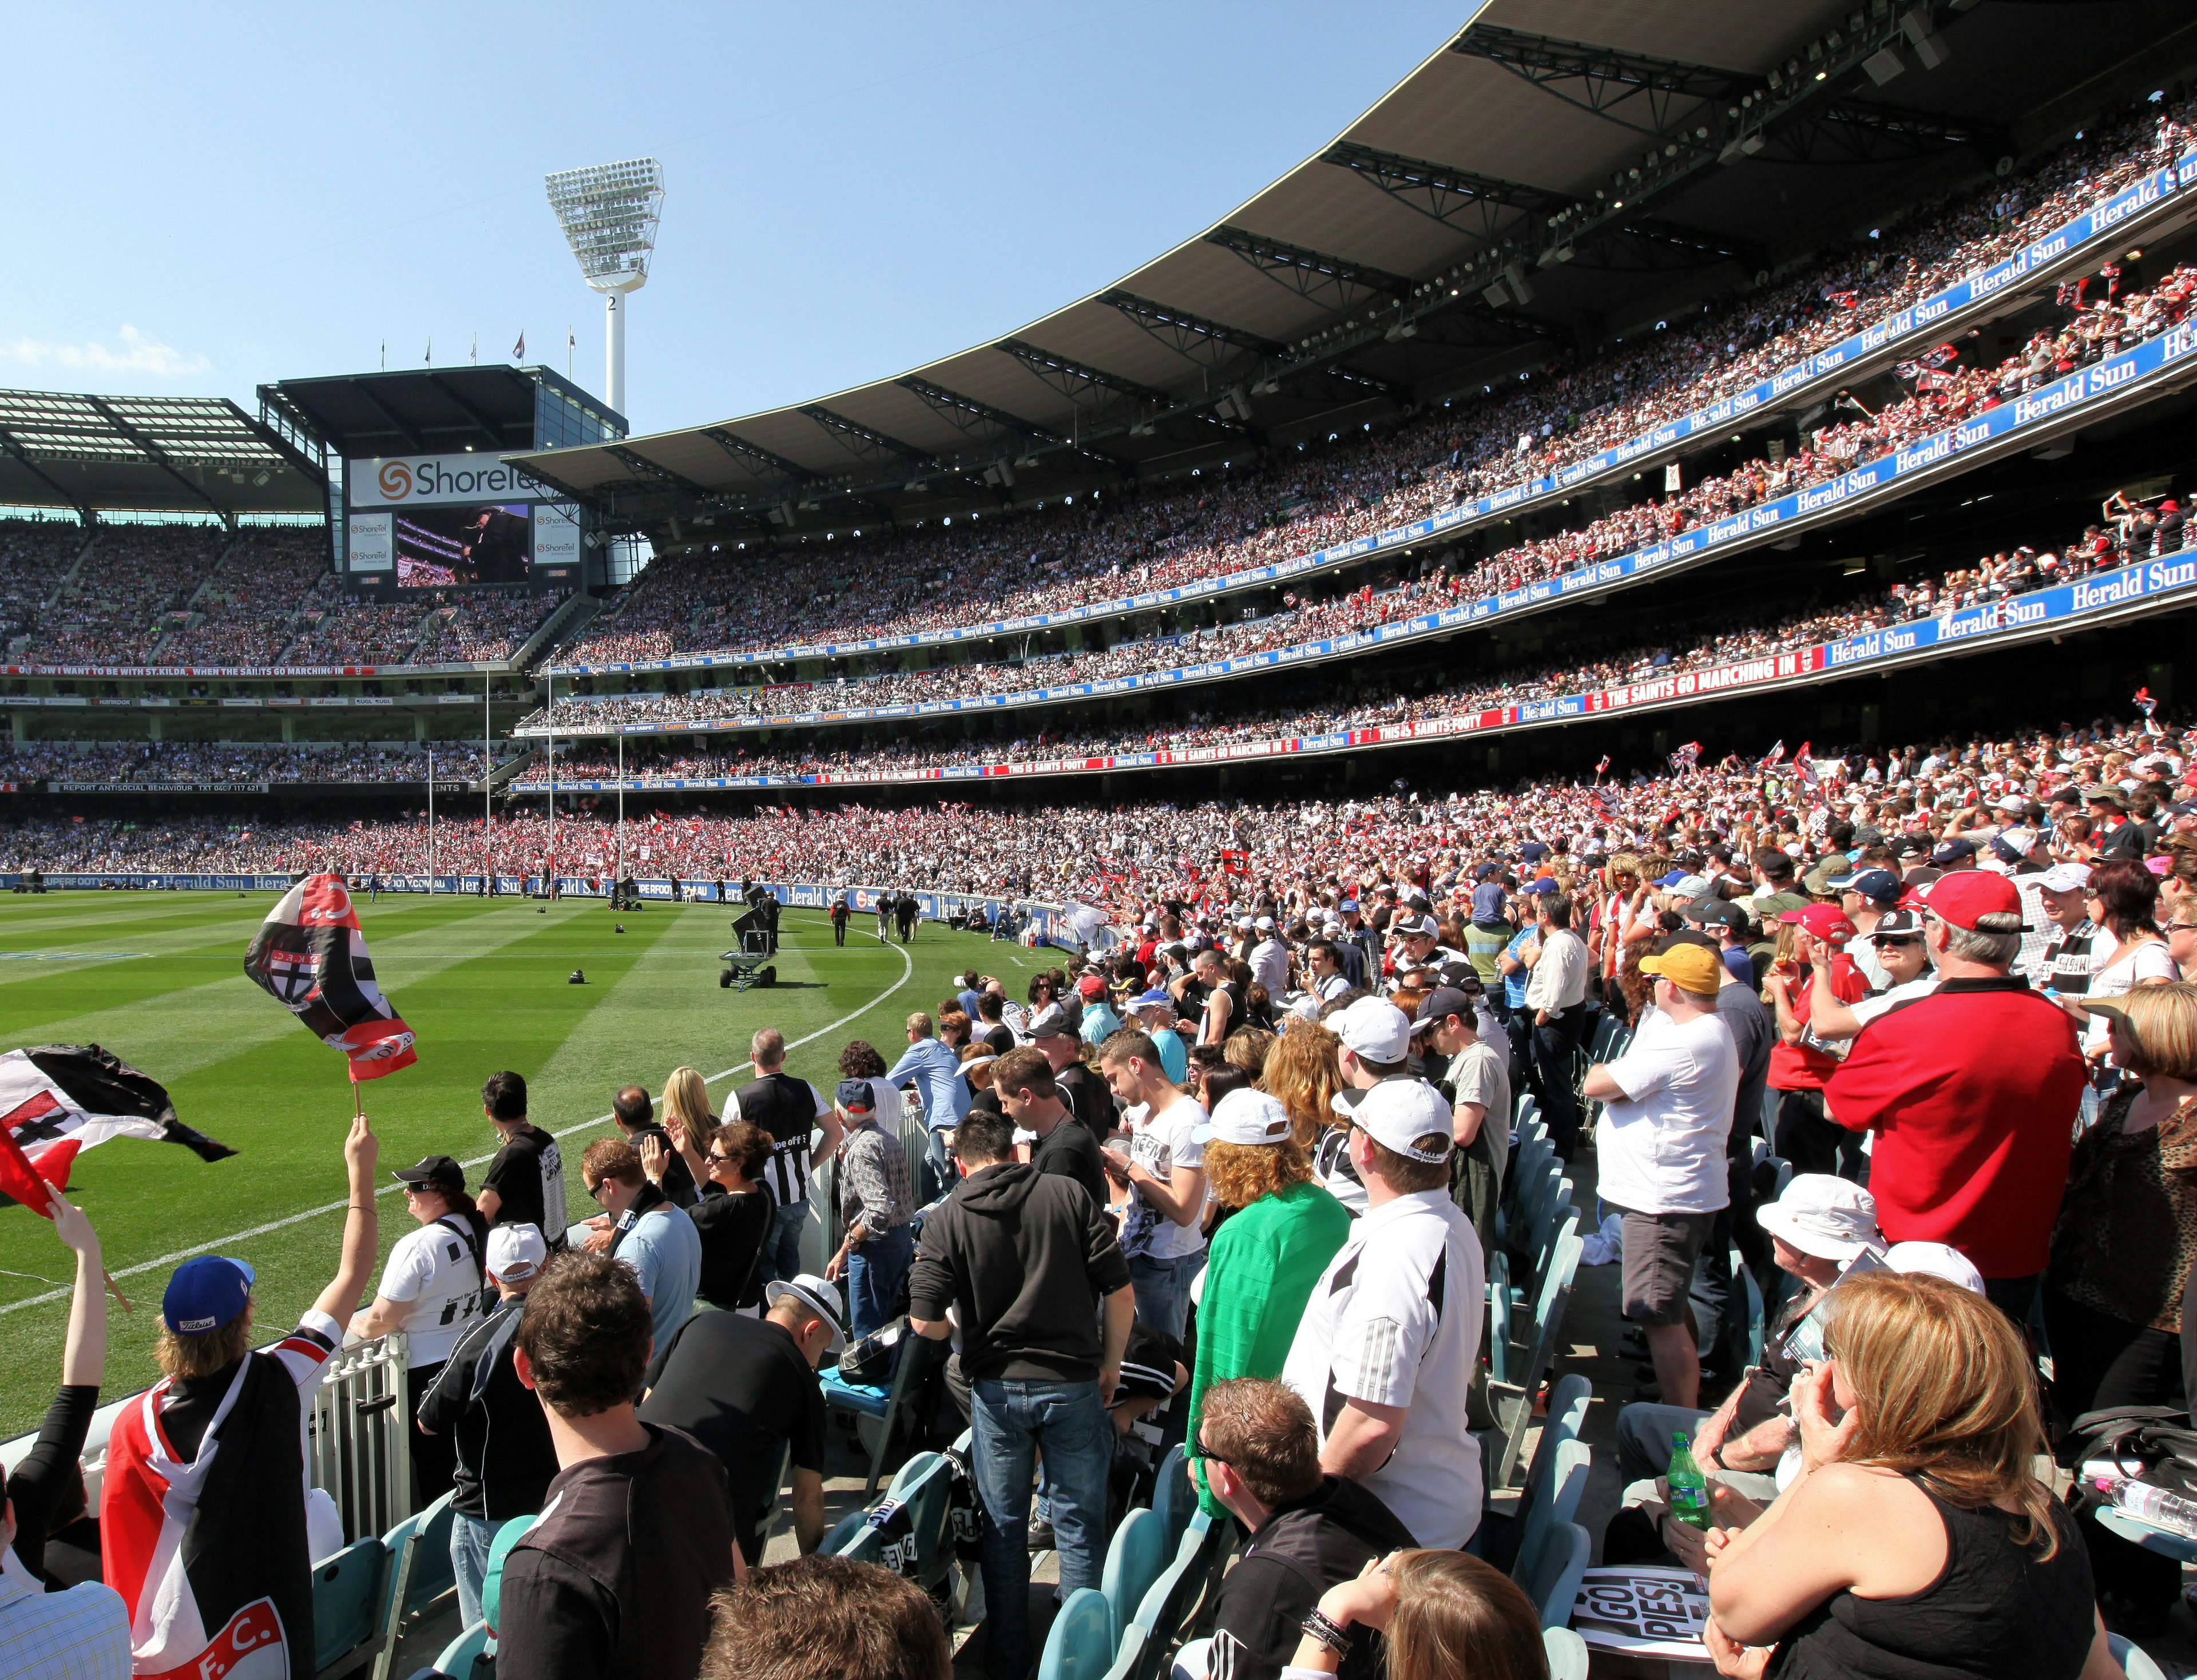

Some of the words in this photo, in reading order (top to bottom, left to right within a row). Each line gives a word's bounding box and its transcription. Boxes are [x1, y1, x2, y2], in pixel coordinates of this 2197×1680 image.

[1969, 252, 2026, 300] Herald
[2032, 234, 2067, 267] Sun
[608, 296, 616, 311] 2
[1817, 350, 1843, 374] Sun
[2014, 374, 2084, 425] Herald
[2091, 356, 2136, 394] Sun
[1617, 435, 1651, 461] Herald
[1654, 427, 1675, 446] Sun
[1895, 433, 1950, 474] Herald
[416, 461, 542, 496] ShoreTe
[1797, 477, 1846, 514] Herald
[1849, 469, 1877, 494] Sun
[359, 525, 386, 533] ShoreTel
[1708, 514, 1748, 544] Herald
[1752, 508, 1779, 529] Sun
[1378, 530, 1405, 546] Herald
[1408, 526, 1424, 538] Sun
[359, 552, 386, 560] ShoreTel
[545, 543, 574, 552] ShoreTel
[1325, 546, 1350, 562] Herald
[1352, 542, 1367, 554] Sun
[1226, 574, 1250, 587] Herald
[1252, 571, 1267, 581] Sun
[1562, 569, 1596, 592] Herald
[1599, 565, 1621, 581] Sun
[2072, 568, 2143, 611] Herald
[2149, 562, 2195, 592] Sun
[1180, 584, 1201, 597] Herald
[1204, 583, 1217, 592] Sun
[1498, 589, 1528, 609] Herald
[1530, 587, 1549, 600] Sun
[1048, 613, 1068, 623] Herald
[1070, 612, 1082, 620] Sun
[2004, 601, 2045, 627] Sun
[1382, 624, 1407, 640] Herald
[1410, 621, 1428, 633] Sun
[836, 644, 856, 653] Herald
[1831, 634, 1879, 665] Herald
[1885, 631, 1915, 652] Sun
[63, 667, 90, 675] WANT
[92, 667, 104, 675] TO
[106, 667, 118, 675] BE
[120, 667, 143, 675] WITH
[193, 667, 219, 675] WHEN
[1182, 665, 1206, 679] Herald
[1208, 664, 1223, 675] Sun
[1607, 688, 1629, 707] THE
[1632, 678, 1675, 703] SAINTS
[1678, 674, 1695, 695] GO
[1698, 658, 1774, 691] MARCHING
[1779, 654, 1795, 676] IN
[1047, 687, 1068, 699] Herald
[1070, 686, 1084, 696] Sun
[961, 698, 981, 708] Herald
[983, 697, 995, 706] Sun
[1557, 699, 1579, 716] Sun
[560, 726, 602, 735] VICLAND
[1379, 726, 1400, 740] THIS
[1415, 719, 1449, 736] SAINTS
[1453, 714, 1482, 731] FOOTY
[1171, 751, 1186, 762] THE
[1188, 749, 1216, 761] SAINTS
[1218, 747, 1228, 759] GO
[1230, 742, 1270, 756] MARCHING
[1272, 741, 1282, 753] IN
[1302, 736, 1328, 750] Herald
[1330, 736, 1344, 747] Sun
[943, 767, 965, 778] Herald
[966, 767, 979, 776] Sun
[1009, 764, 1024, 774] THIS
[1026, 764, 1033, 772] IS
[1035, 762, 1060, 772] SAINTS
[1063, 760, 1086, 770] FOOTY
[725, 779, 745, 787] Herald
[830, 775, 842, 783] THE
[870, 773, 880, 782] GO
[919, 770, 926, 779] IN
[1816, 809, 1826, 819] GO
[162, 875, 212, 889] Herald
[219, 875, 244, 889] Sun
[786, 886, 823, 906] Herald
[788, 1135, 801, 1146] off
[182, 1321, 213, 1330] Titleist
[1588, 1587, 1637, 1620] GO
[1634, 1580, 1693, 1638] PIES!
